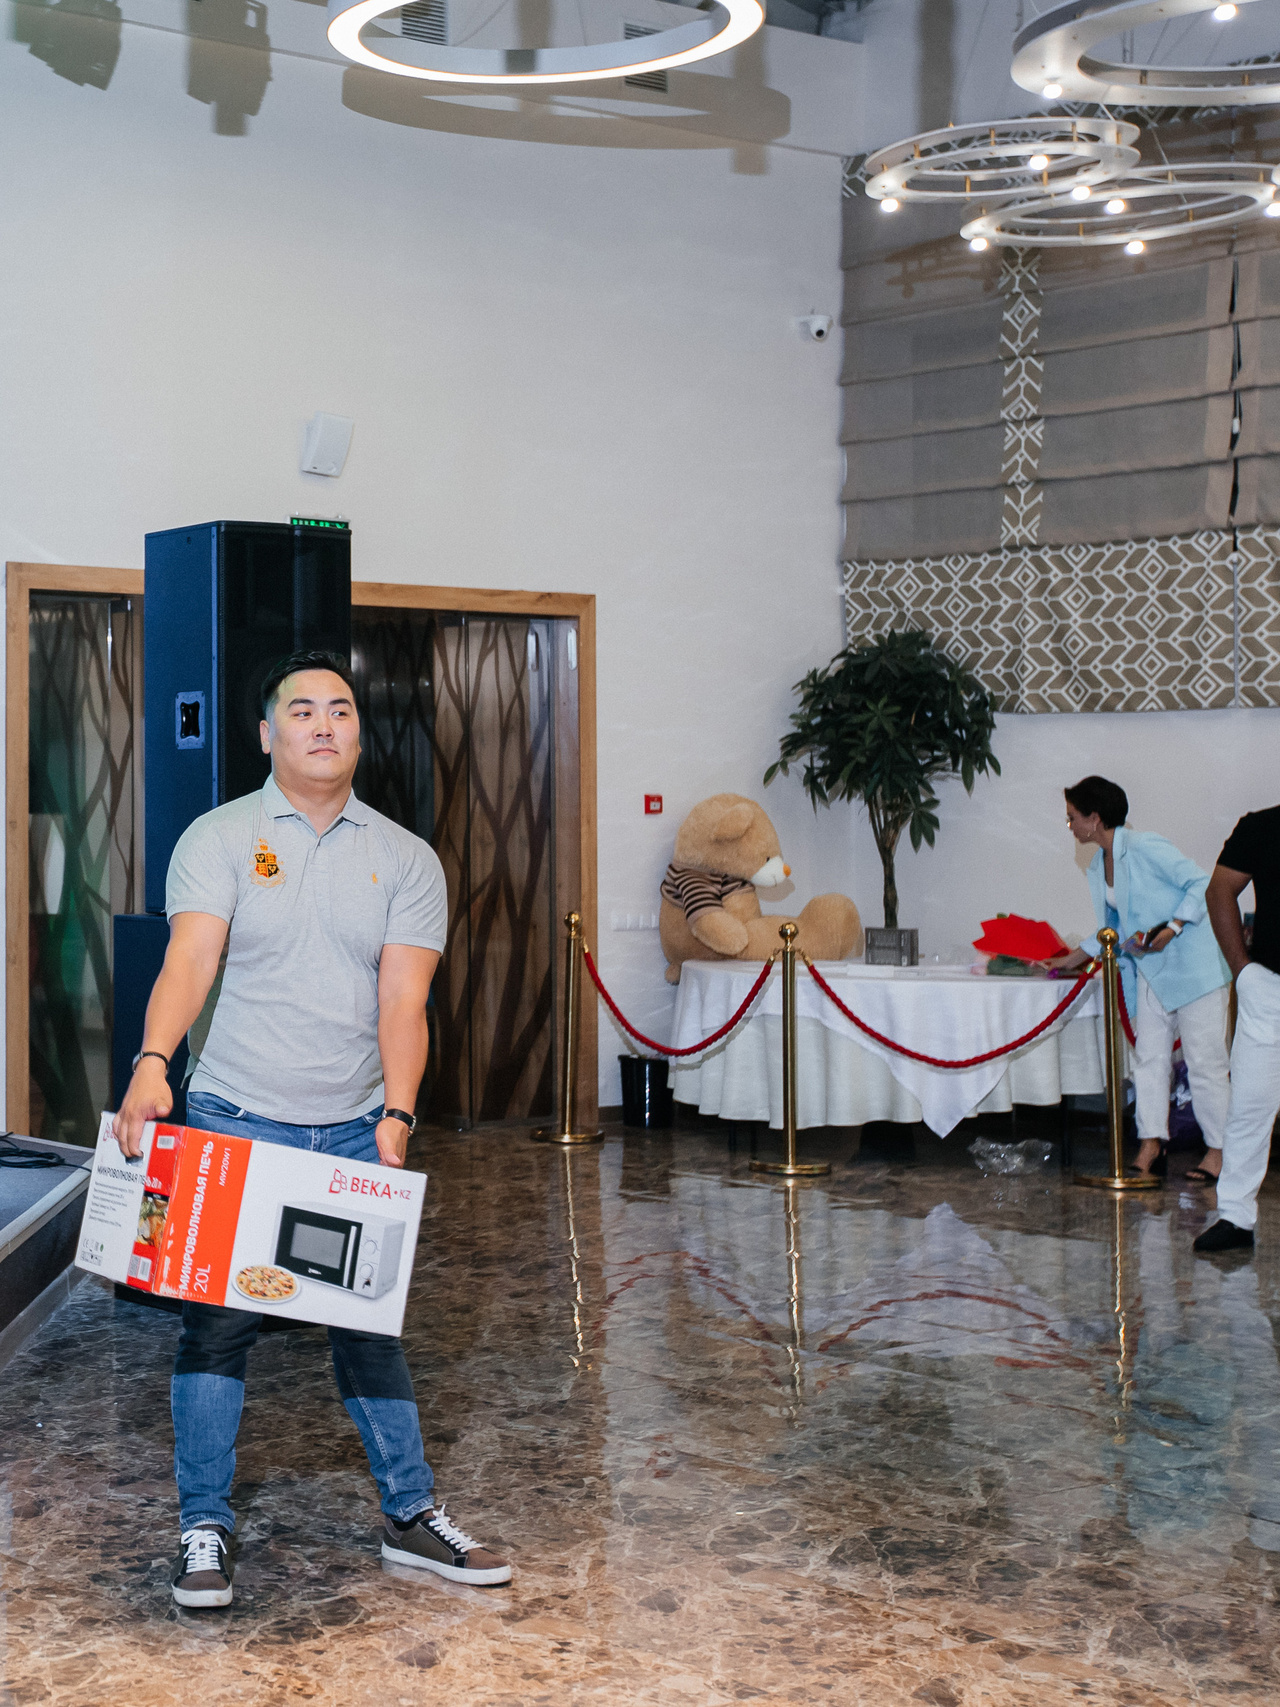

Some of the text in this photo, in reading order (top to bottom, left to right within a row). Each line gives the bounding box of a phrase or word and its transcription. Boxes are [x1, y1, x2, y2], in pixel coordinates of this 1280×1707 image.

[218, 1147, 232, 1187] MW20W1
[350, 1176, 392, 1200] BEKA
[178, 1140, 214, 1291] МИКРОВОЛНОВАЯ ПЕЧЬ
[193, 1264, 211, 1294] 20L
